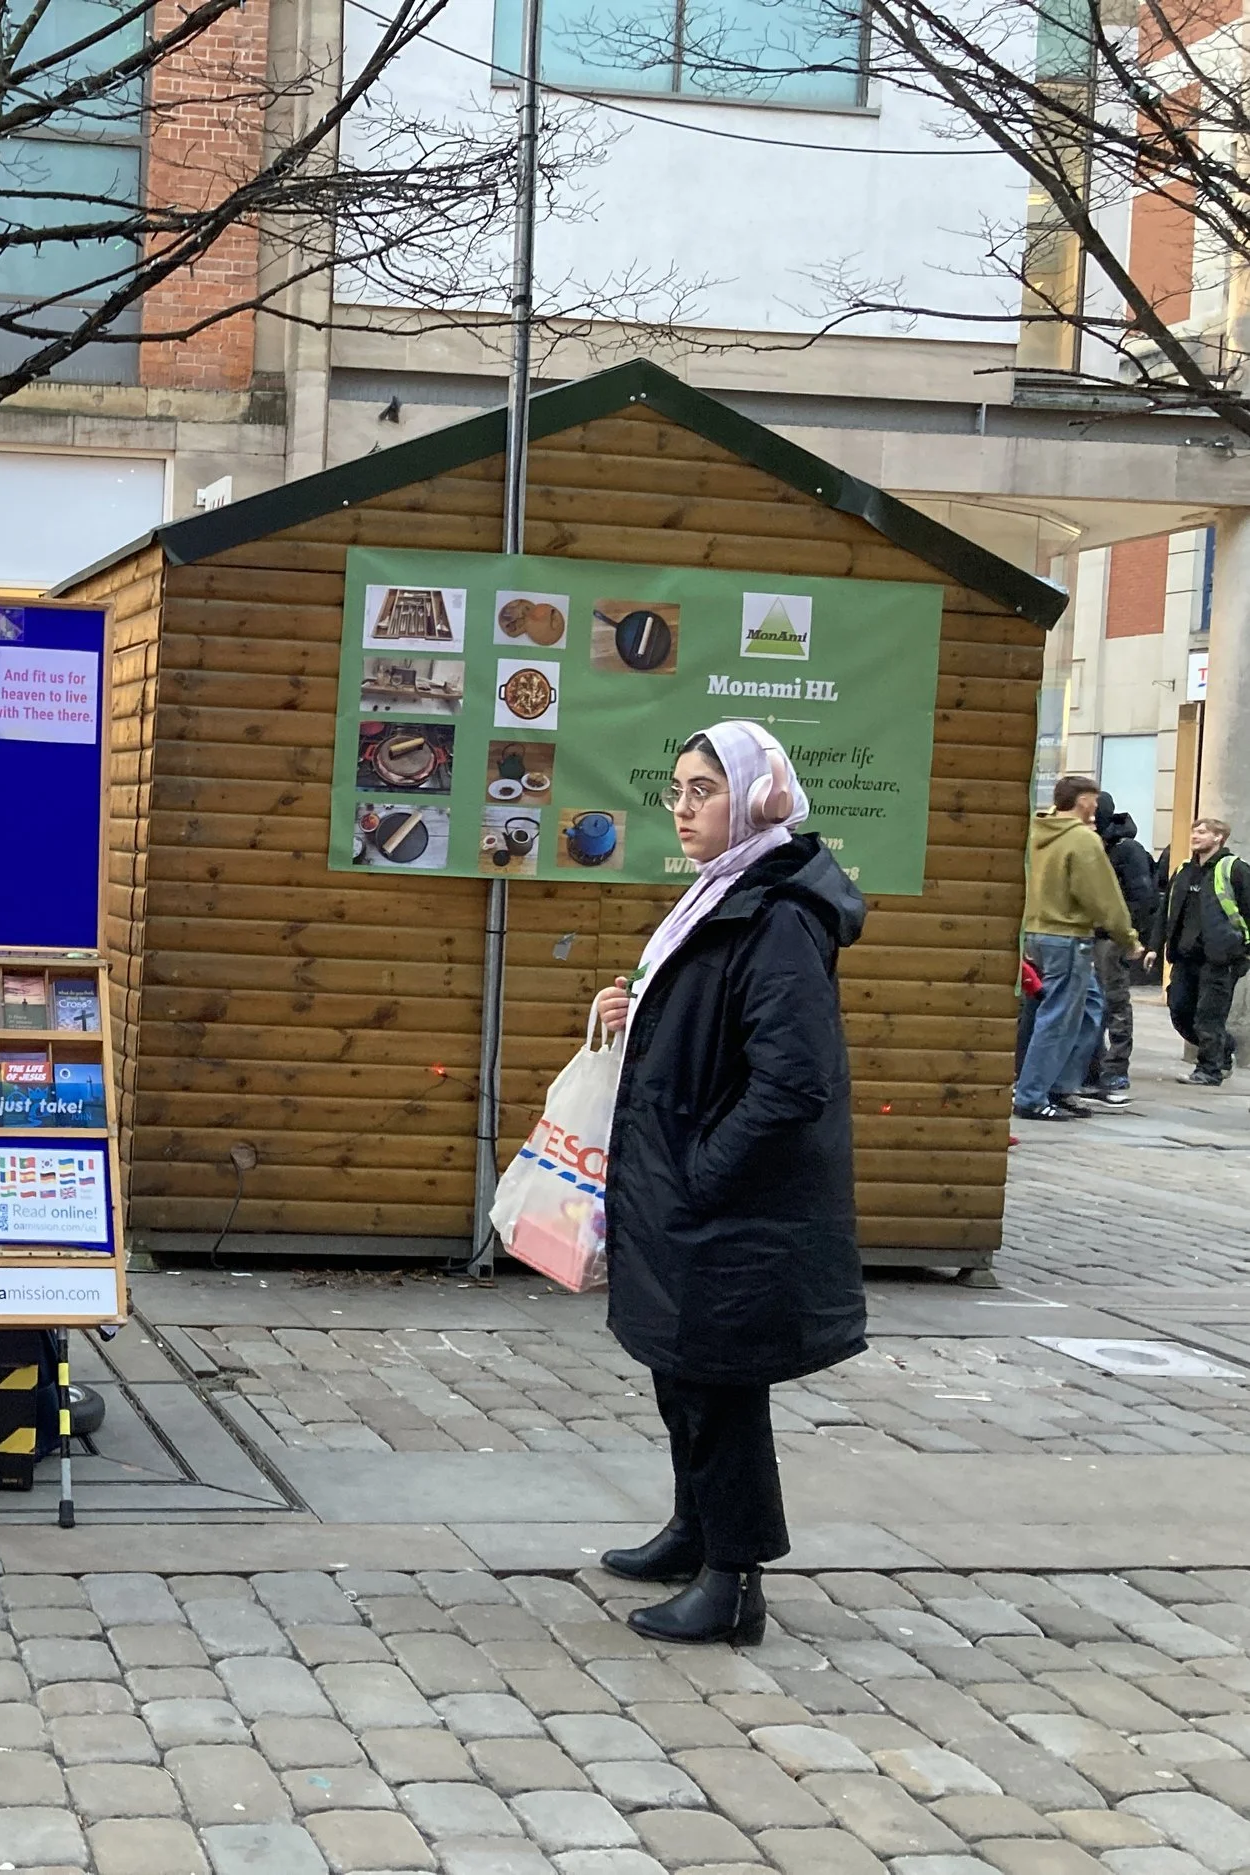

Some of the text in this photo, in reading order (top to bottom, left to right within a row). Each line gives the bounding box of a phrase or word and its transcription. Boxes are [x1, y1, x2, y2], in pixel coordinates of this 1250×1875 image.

[746, 628, 807, 642] MonAmi
[4, 669, 86, 685] And fit us for
[1, 687, 88, 703] heaven to live
[707, 675, 839, 702] Monami HL
[23, 707, 54, 720] Thee
[58, 708, 94, 723] there.
[790, 745, 874, 770] Happier life
[828, 774, 900, 793] cookware,
[809, 798, 887, 818] homeware.
[58, 1000, 92, 1008] Cross?
[8, 1064, 45, 1073] THE LIFE
[6, 1073, 47, 1082] OF JESUS
[0, 1095, 32, 1116] just
[38, 1098, 83, 1114] take!
[527, 1119, 609, 1184] TESC
[12, 1204, 98, 1220] Read online!
